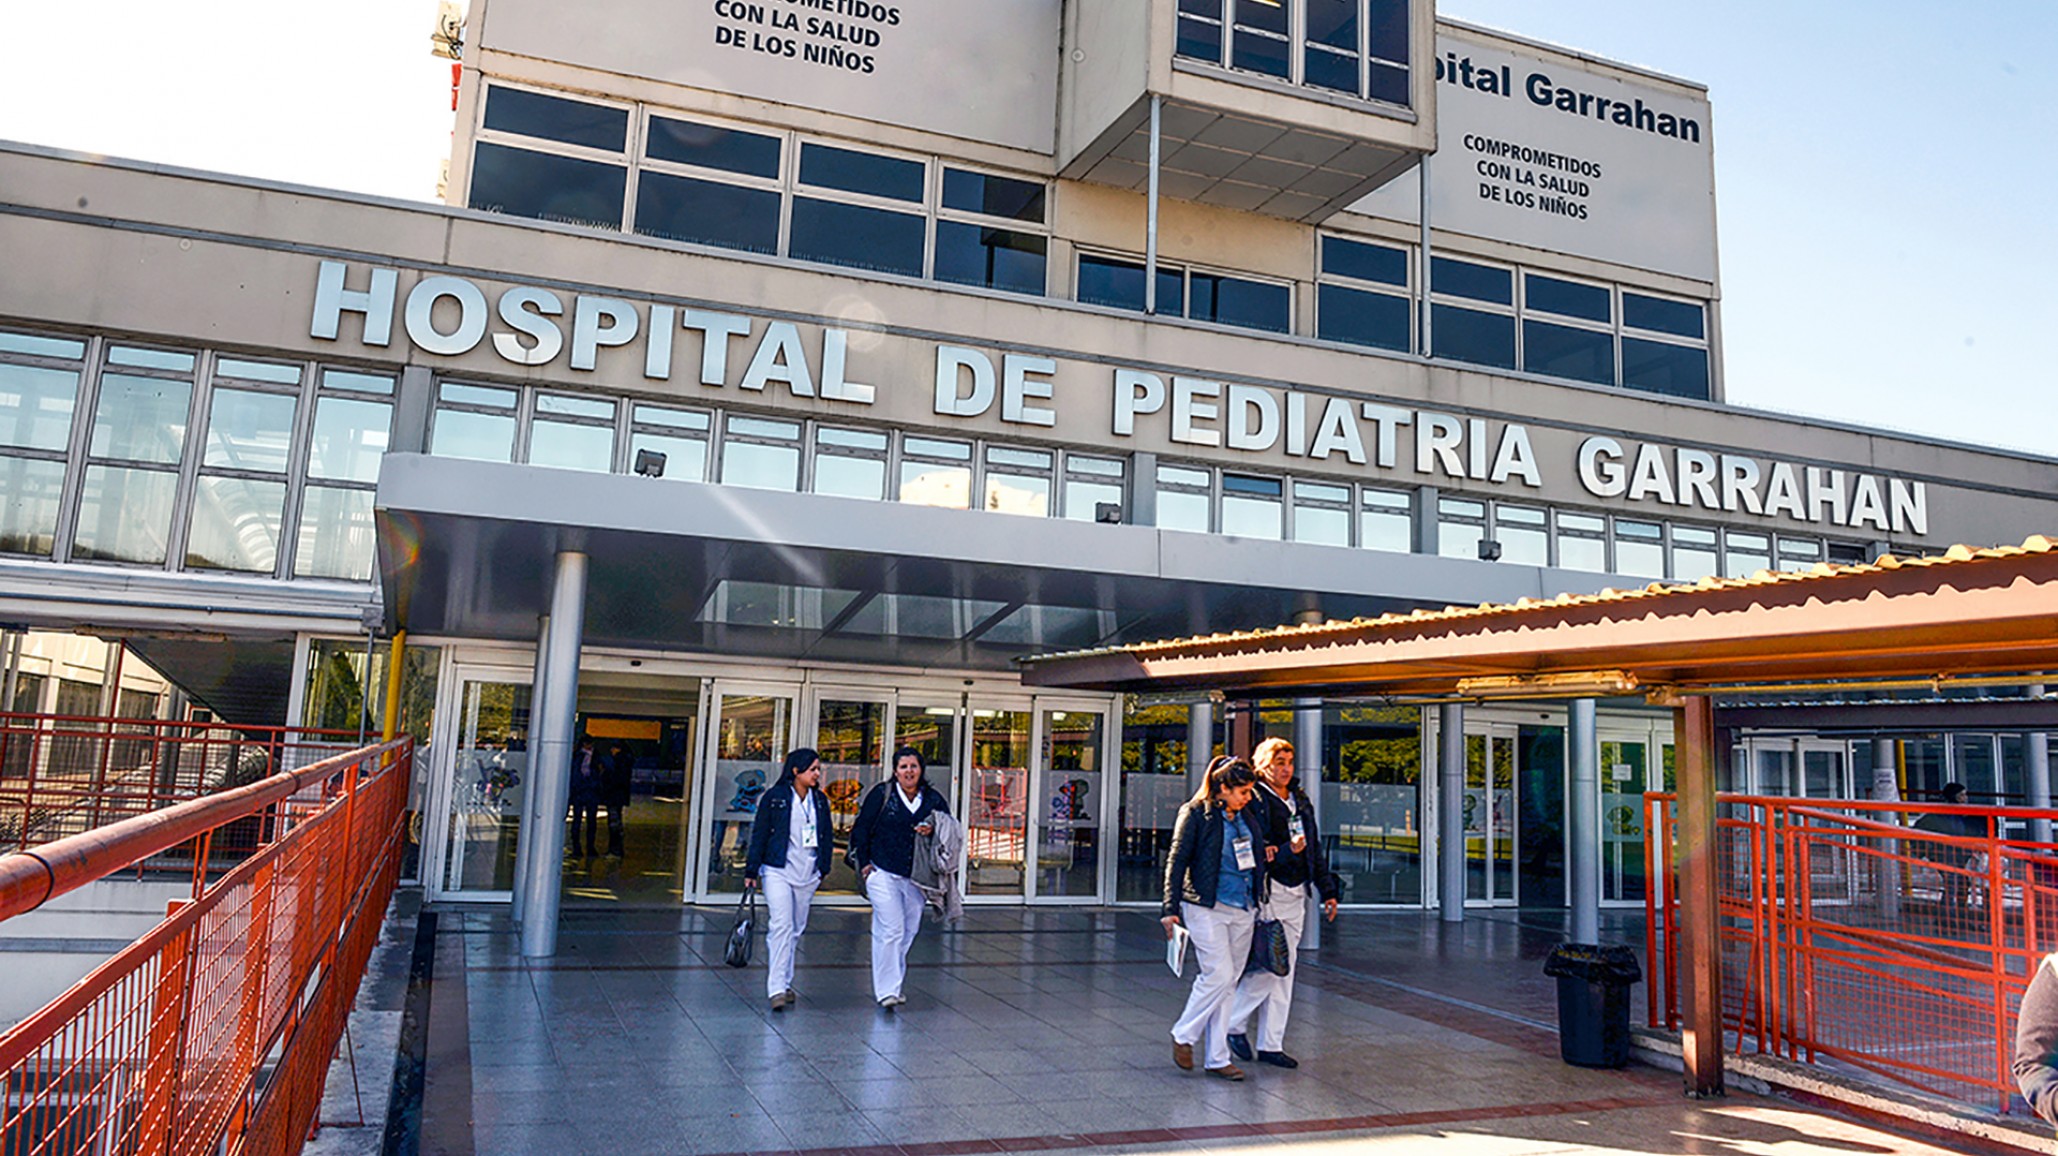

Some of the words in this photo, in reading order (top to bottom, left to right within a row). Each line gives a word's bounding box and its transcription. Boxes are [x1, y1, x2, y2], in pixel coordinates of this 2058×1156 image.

[714, 0, 764, 25] CON
[771, 10, 800, 32] LA
[806, 17, 881, 48] SALUD
[715, 26, 747, 48] DE
[753, 33, 797, 58] LOS
[803, 43, 875, 74] NIÑOS
[1525, 72, 1700, 144] Garrahan
[1463, 134, 1602, 179] COMPROMETIDOS
[1476, 159, 1511, 181] CON
[1515, 167, 1536, 187] LA
[1538, 173, 1590, 198] SALUD
[1479, 182, 1501, 202] DE
[1504, 188, 1535, 209] LOS
[1538, 195, 1589, 221] NIÑOS
[310, 259, 876, 405] HOSPITAL
[934, 344, 1057, 427] DE
[1111, 367, 1543, 488] PEDIATRIA
[1576, 435, 1929, 536] GARRAHAN
